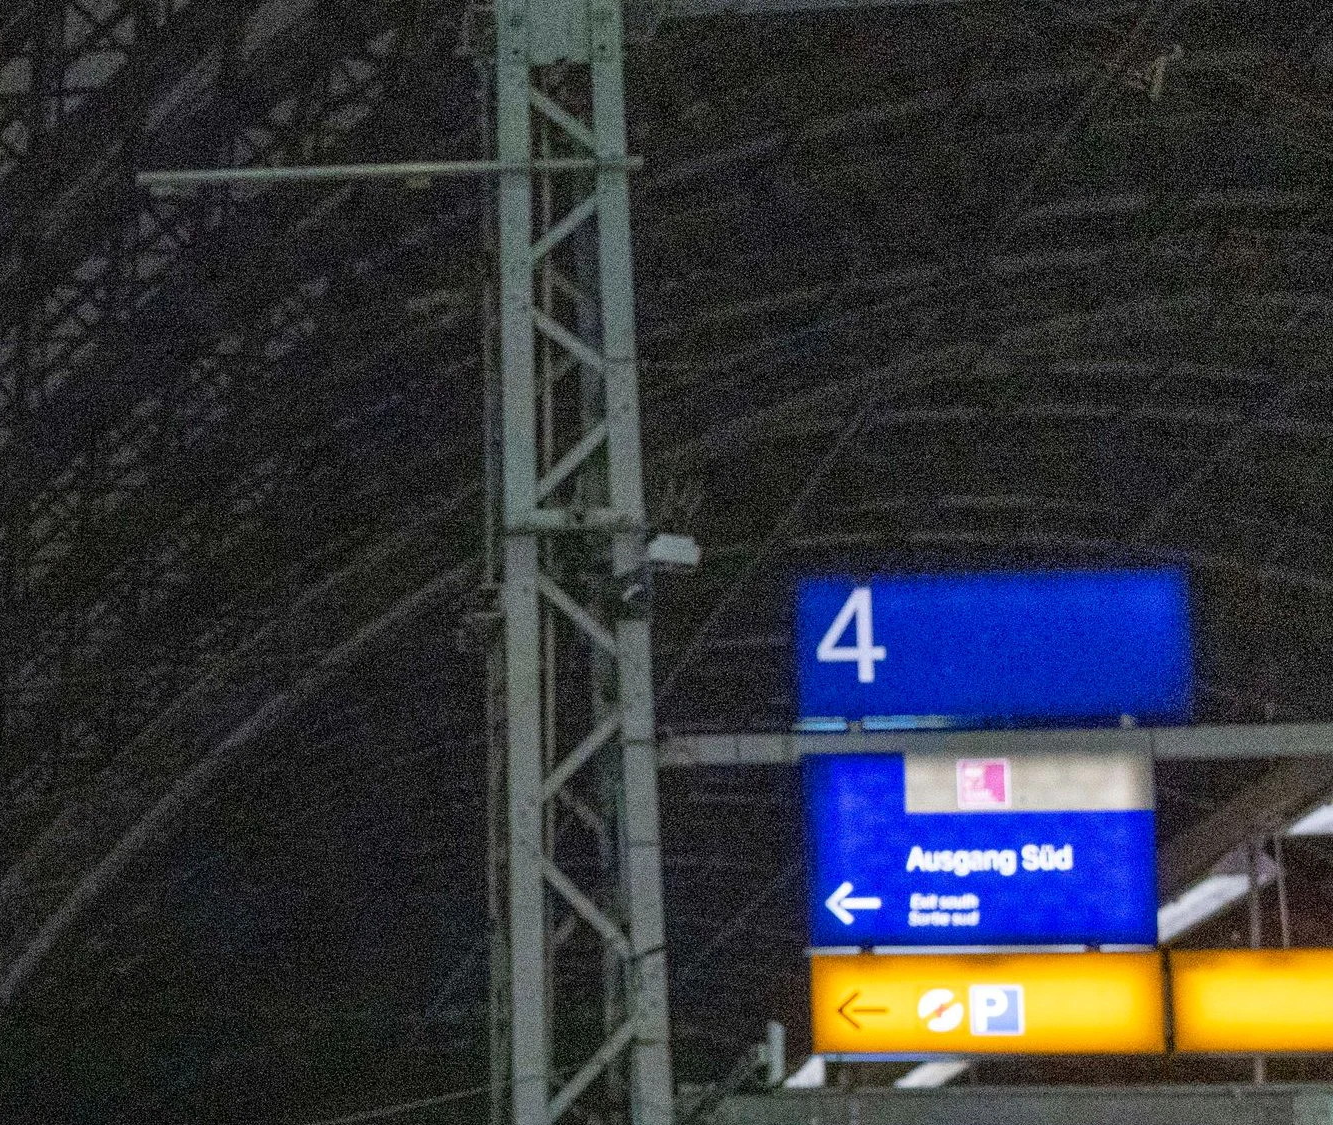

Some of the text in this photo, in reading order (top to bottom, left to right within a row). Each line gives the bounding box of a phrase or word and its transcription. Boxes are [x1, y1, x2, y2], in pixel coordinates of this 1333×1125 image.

[816, 587, 887, 683] 4
[907, 844, 1073, 876] Ausgang Süd
[974, 987, 1008, 1033] P
